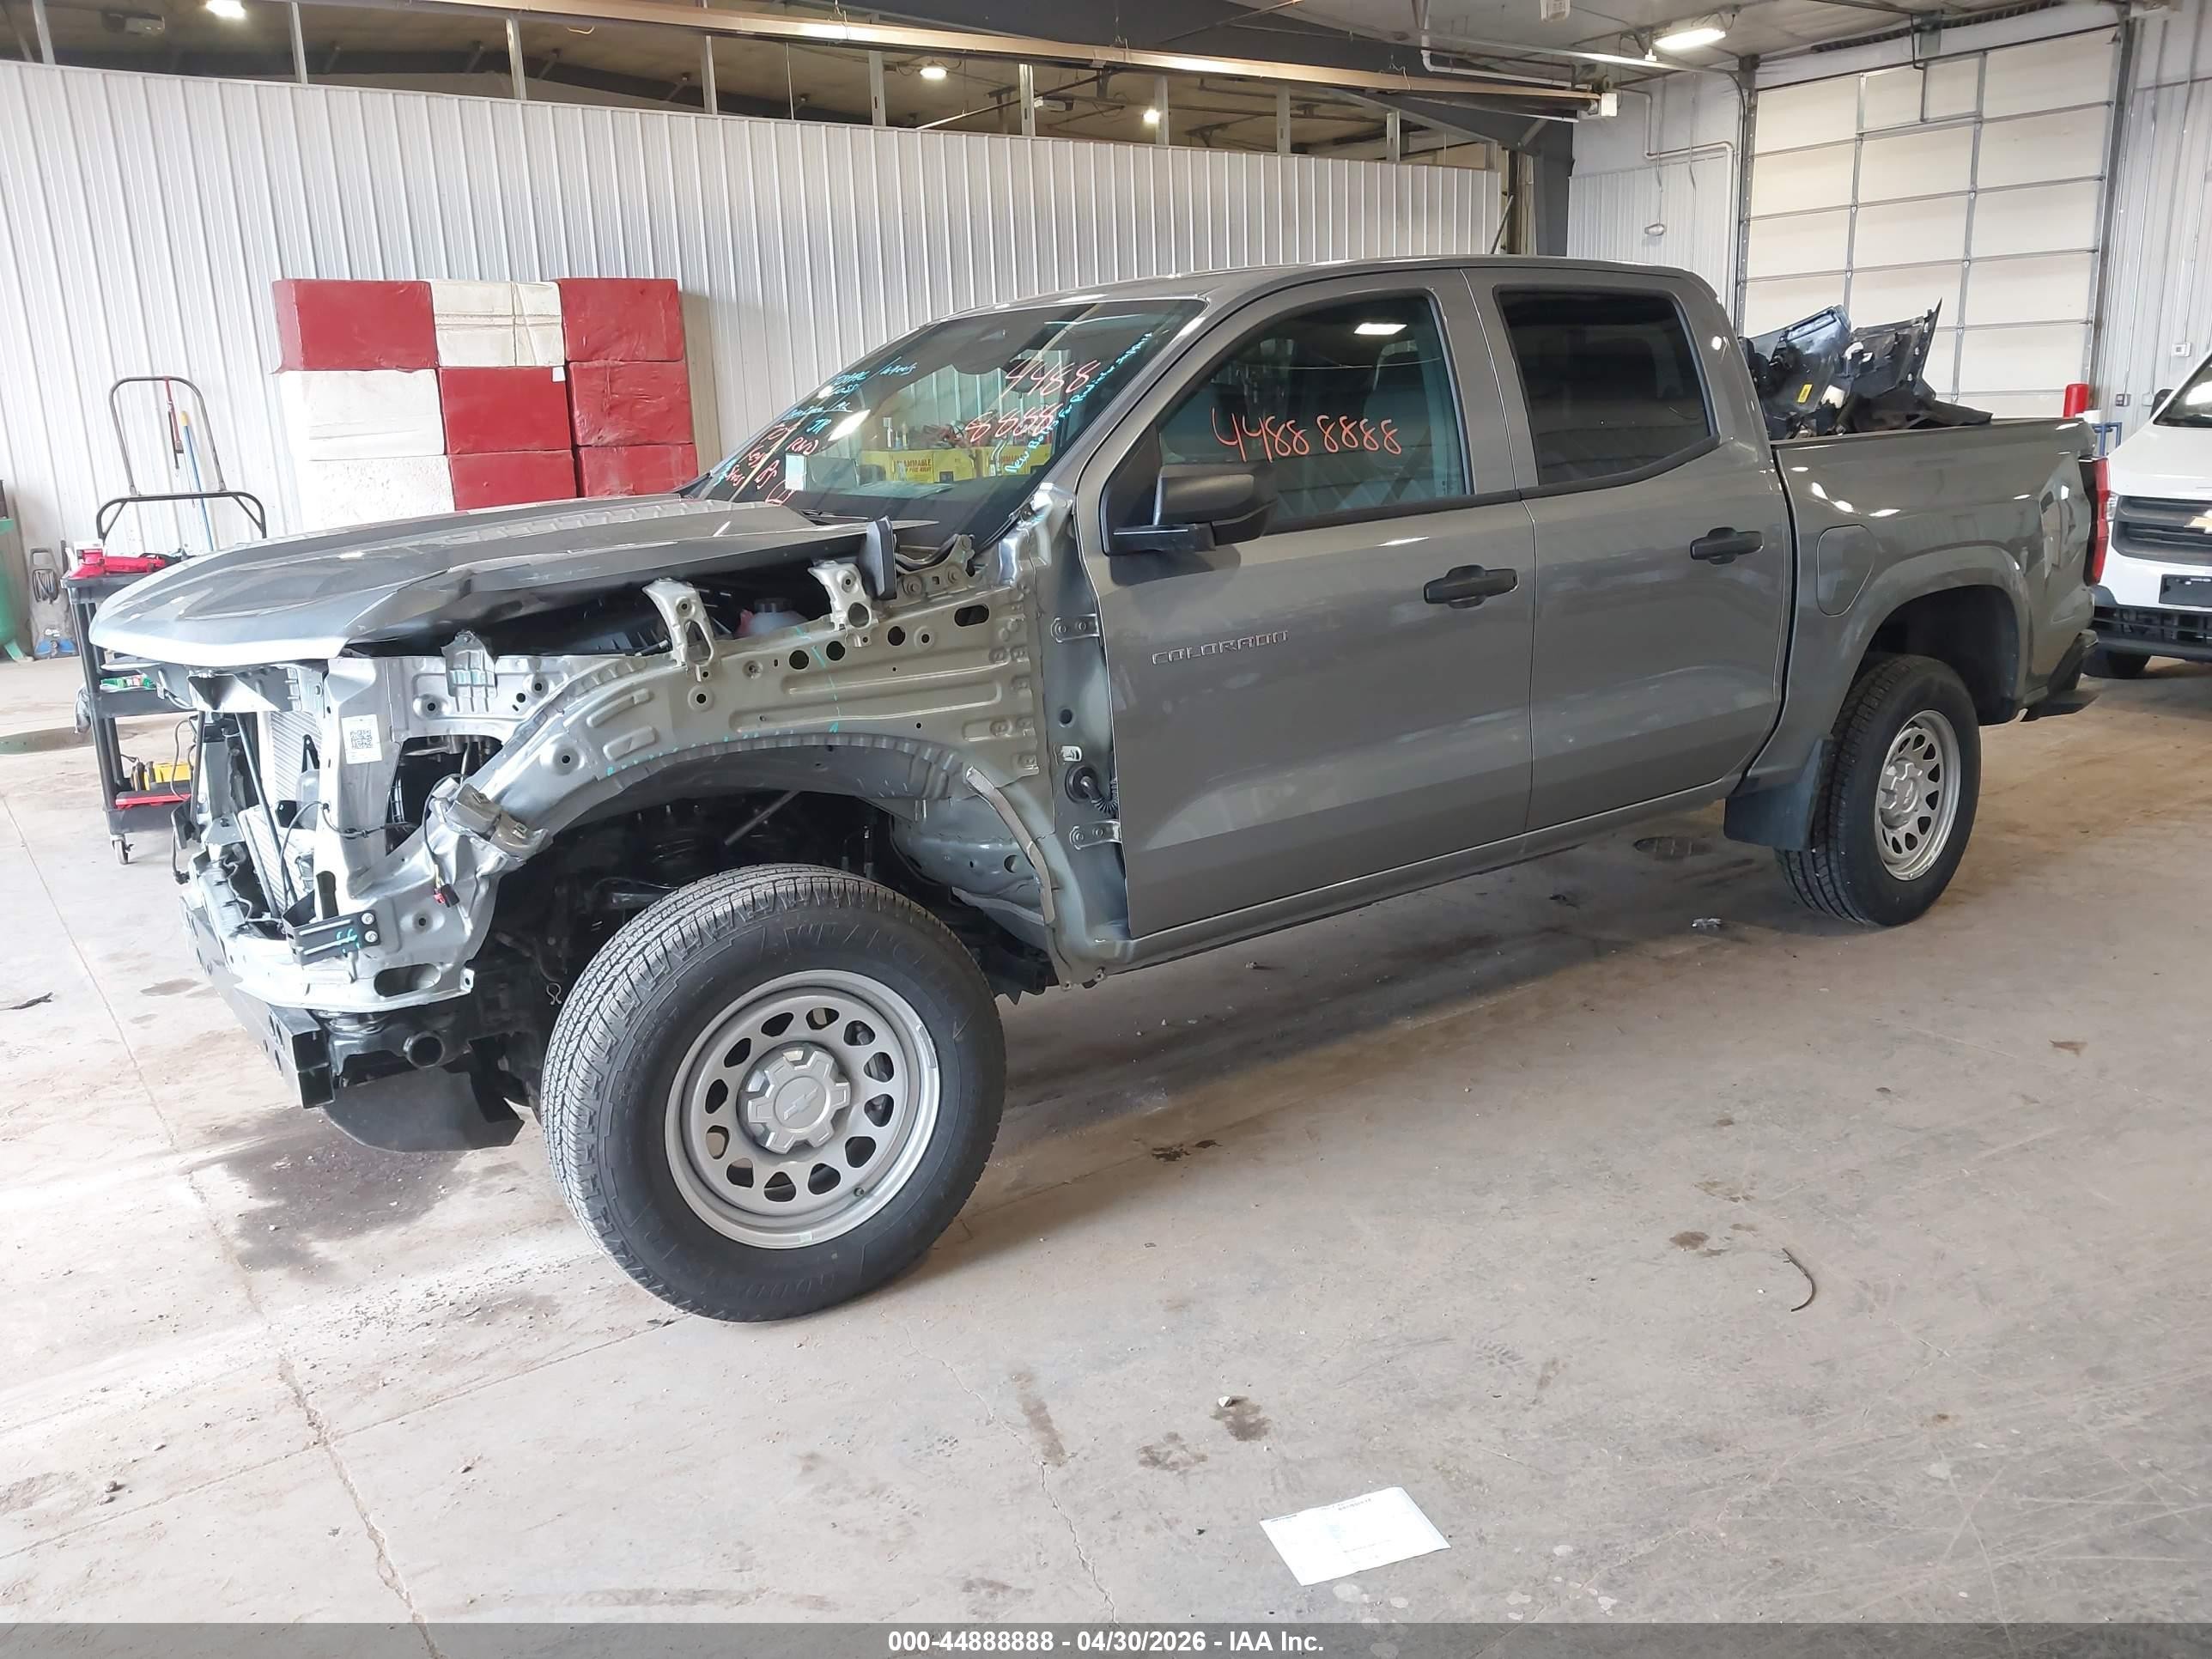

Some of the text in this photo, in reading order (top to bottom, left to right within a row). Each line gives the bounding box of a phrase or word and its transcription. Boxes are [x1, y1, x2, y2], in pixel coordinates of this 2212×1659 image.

[1001, 356, 1101, 398] 4488
[964, 403, 1063, 442] 8888
[1212, 407, 1401, 462] 4488 8888
[1152, 629, 1290, 665] COLORADO
